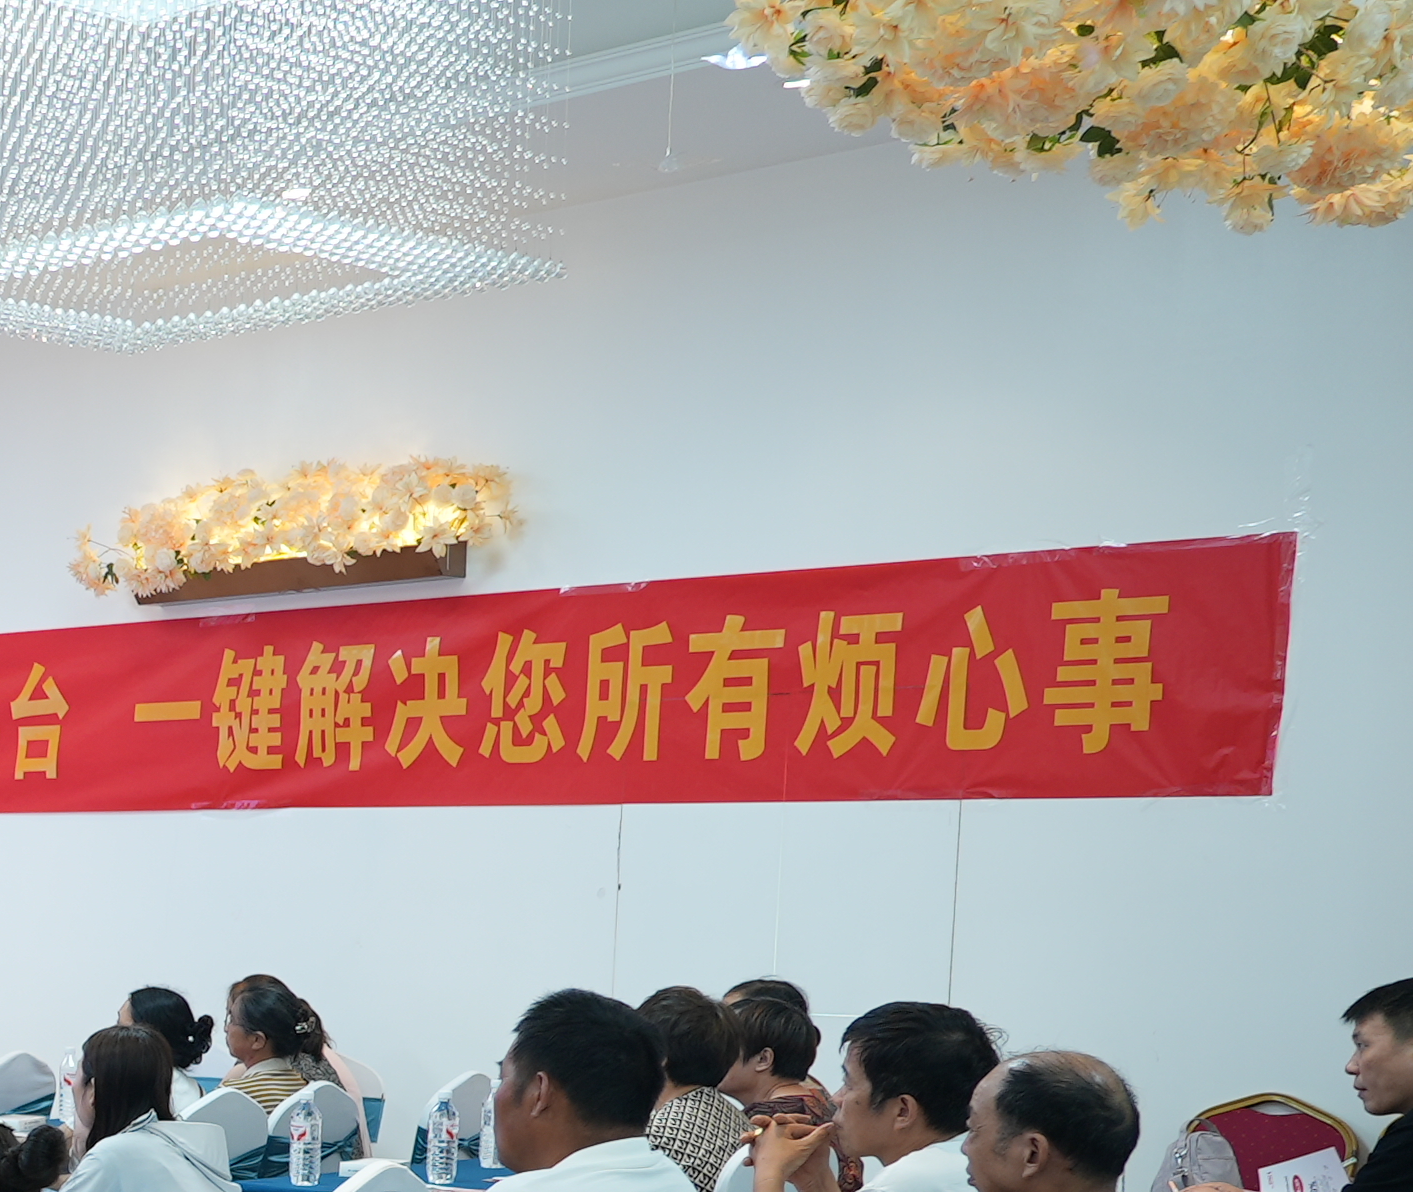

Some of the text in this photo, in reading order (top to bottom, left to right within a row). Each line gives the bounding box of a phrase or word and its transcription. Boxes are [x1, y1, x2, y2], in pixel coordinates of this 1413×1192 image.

[135, 588, 1170, 771] 一键解决您所有烦心事
